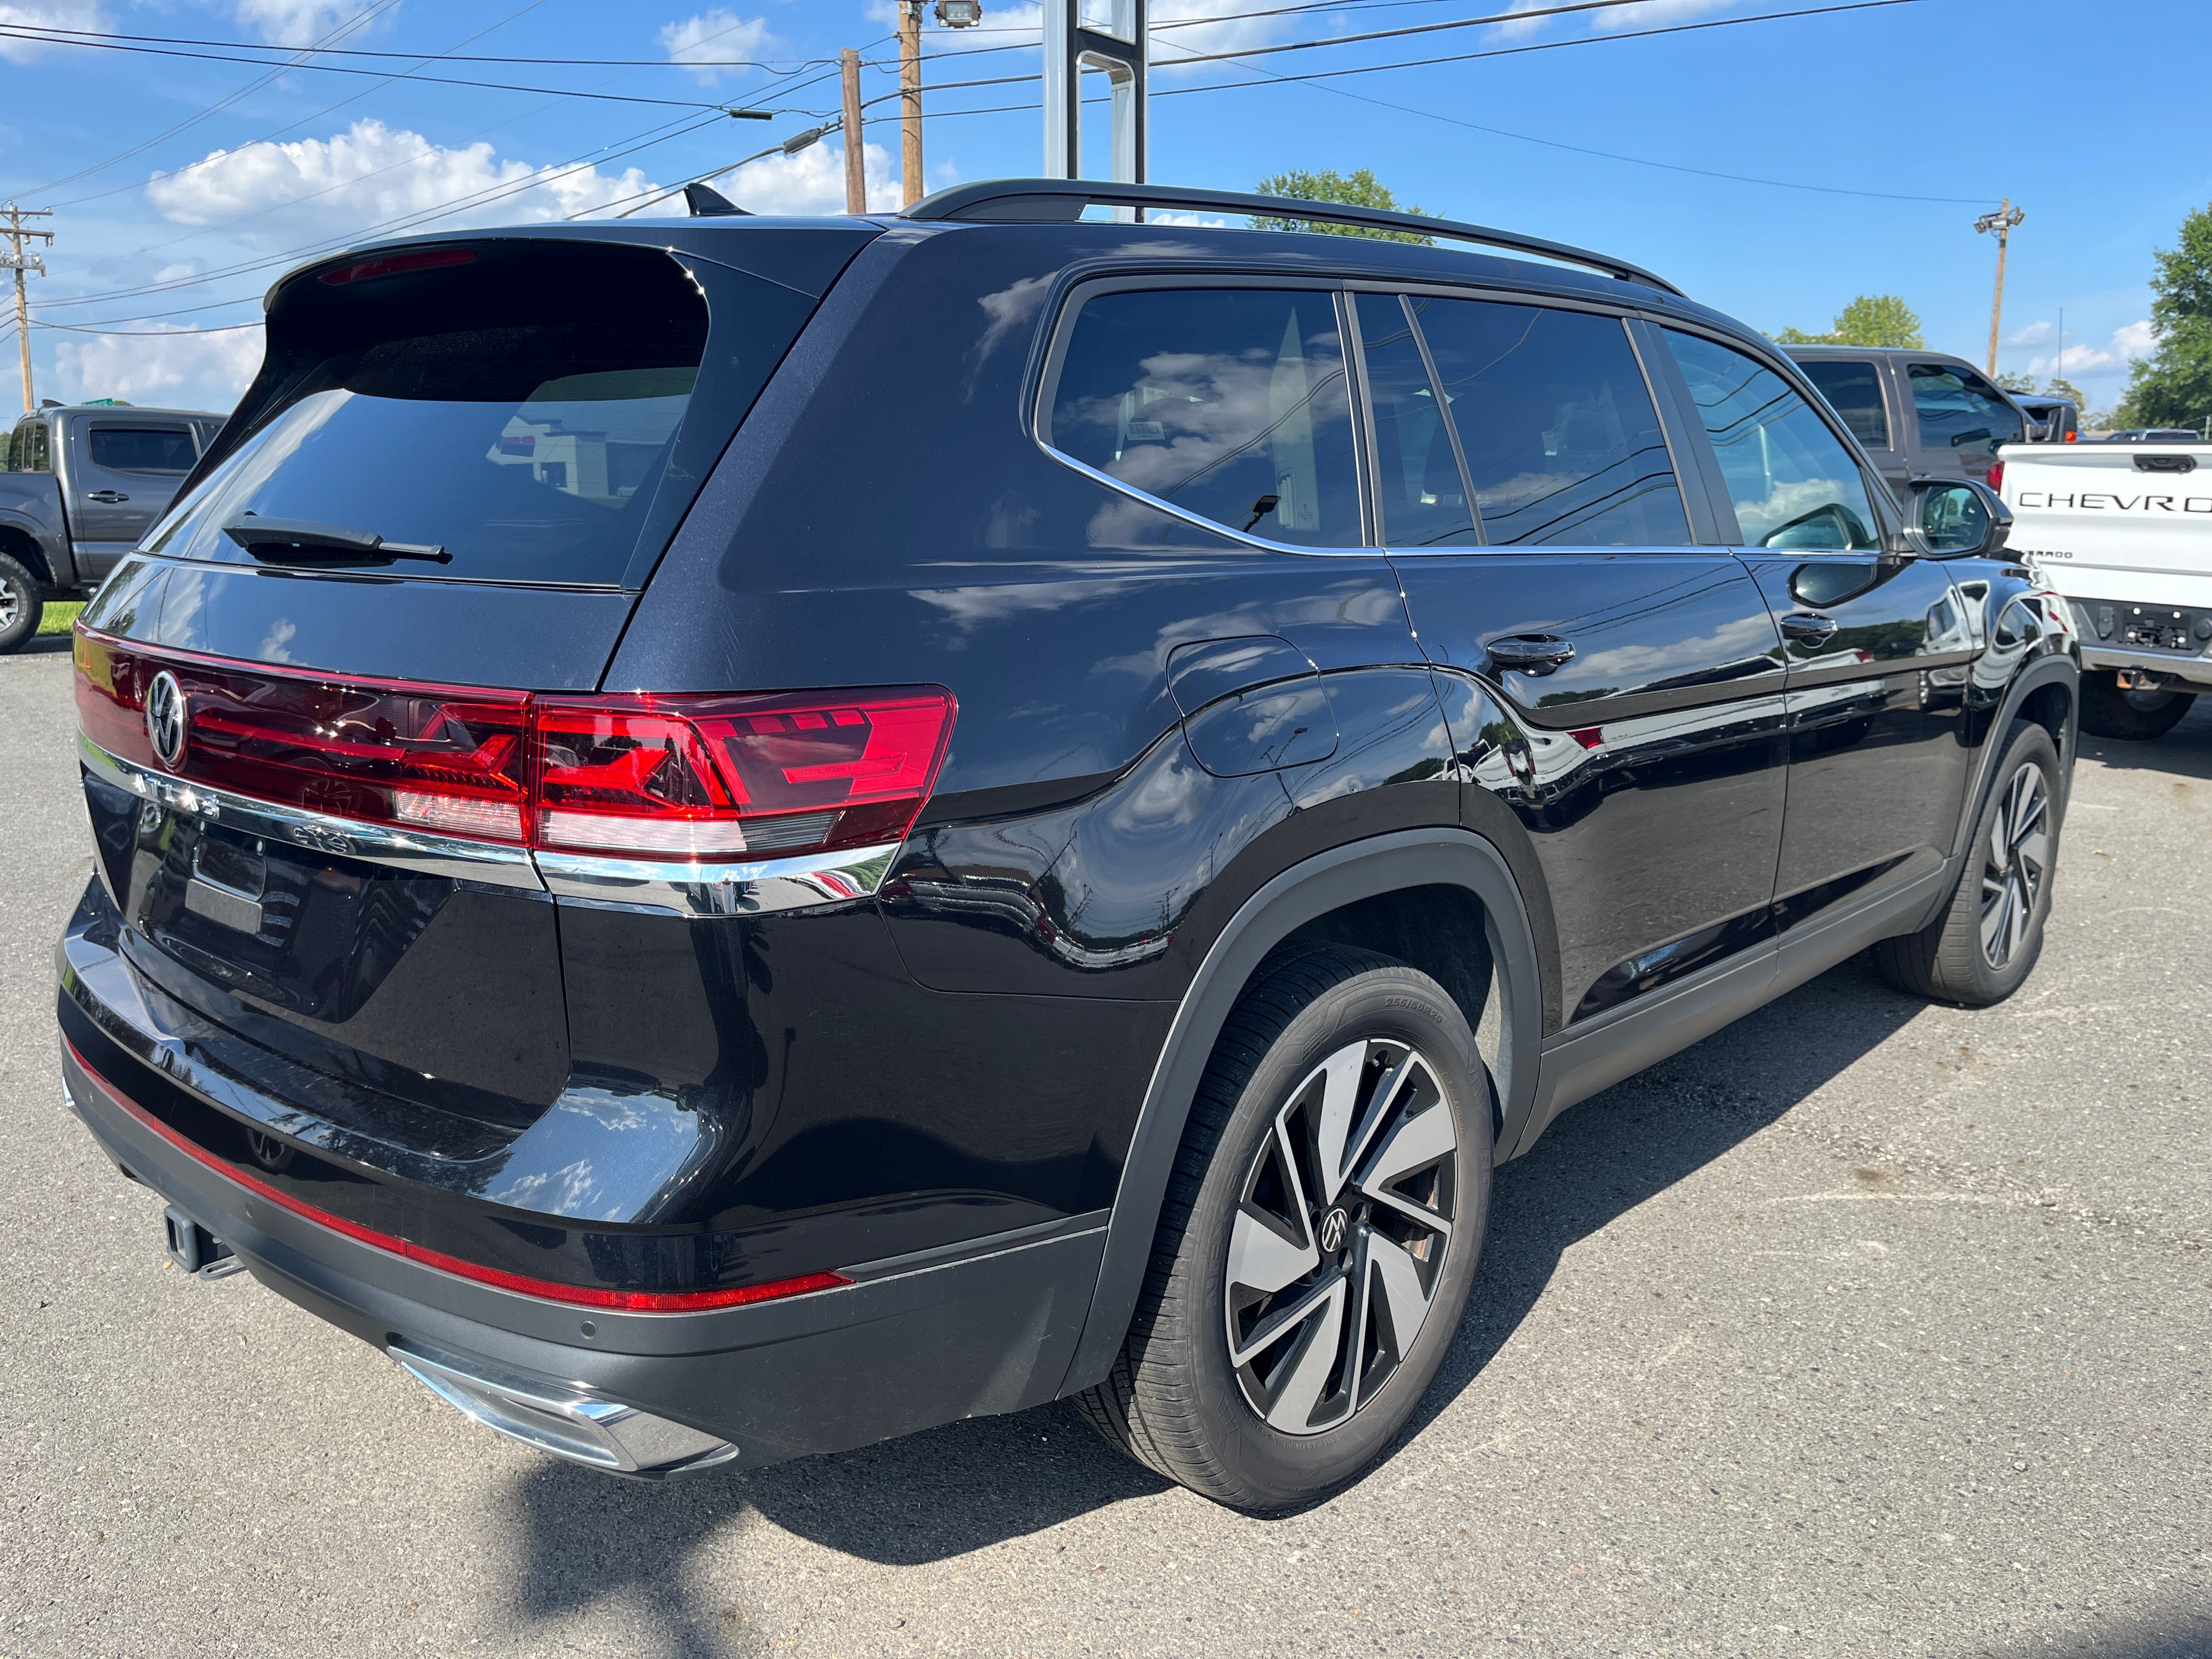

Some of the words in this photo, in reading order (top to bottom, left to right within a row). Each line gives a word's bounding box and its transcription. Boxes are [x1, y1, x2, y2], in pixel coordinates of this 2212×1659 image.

[2019, 492, 2212, 513] CHEVRO
[133, 772, 220, 820] ATLAS
[1385, 998, 1443, 1023] 255/50R20
[1204, 1133, 1255, 1308] NEXEN
